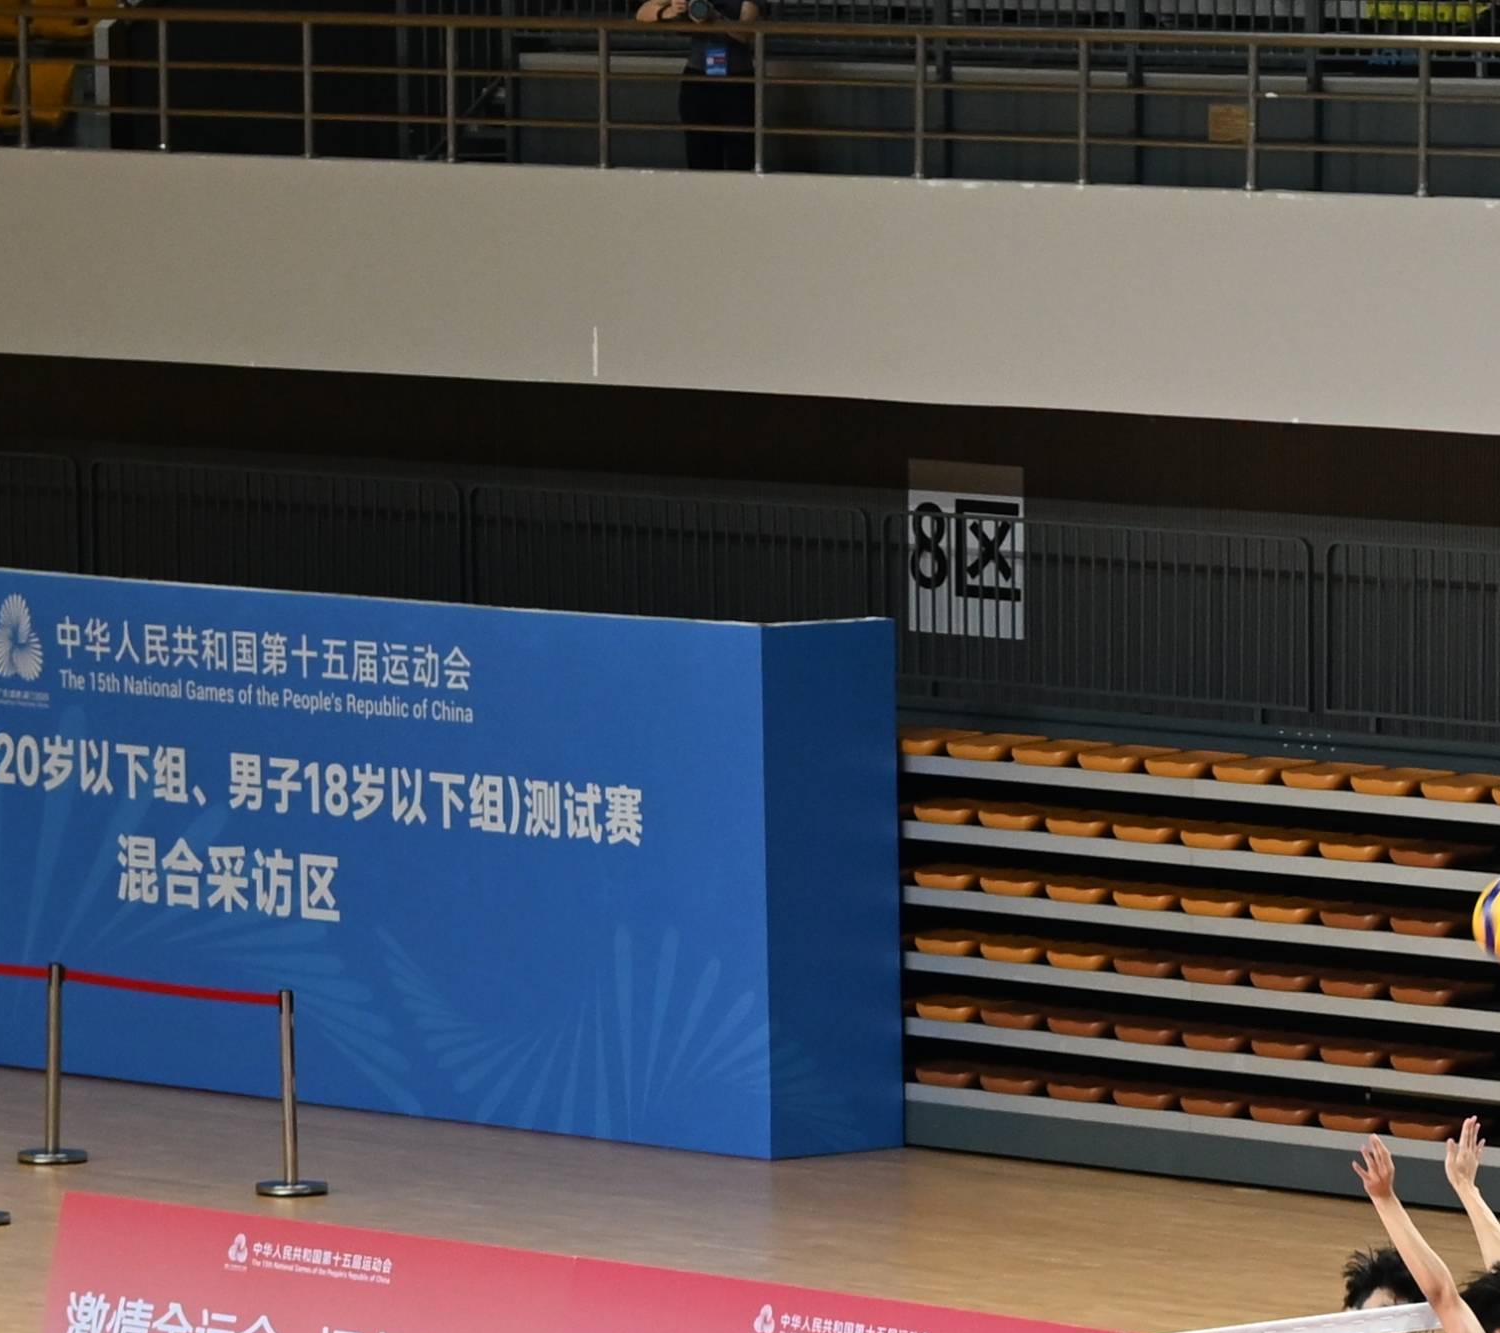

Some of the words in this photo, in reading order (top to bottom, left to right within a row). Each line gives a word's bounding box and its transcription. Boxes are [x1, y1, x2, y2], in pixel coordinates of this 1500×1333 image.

[910, 498, 1021, 602] 8区
[57, 615, 471, 691] 中华人民共和国第十五届运动会
[60, 669, 84, 690] The
[89, 672, 119, 692] 15th
[124, 676, 182, 699] National
[186, 681, 234, 703] Games
[238, 685, 254, 705] of
[257, 686, 279, 707] the
[284, 689, 342, 713] People's
[346, 694, 409, 719] Republic
[413, 699, 427, 720] of
[432, 700, 473, 723] China
[118, 836, 341, 923] 混合采访区
[253, 1242, 392, 1274] 中华人民共和国第十五届运动会
